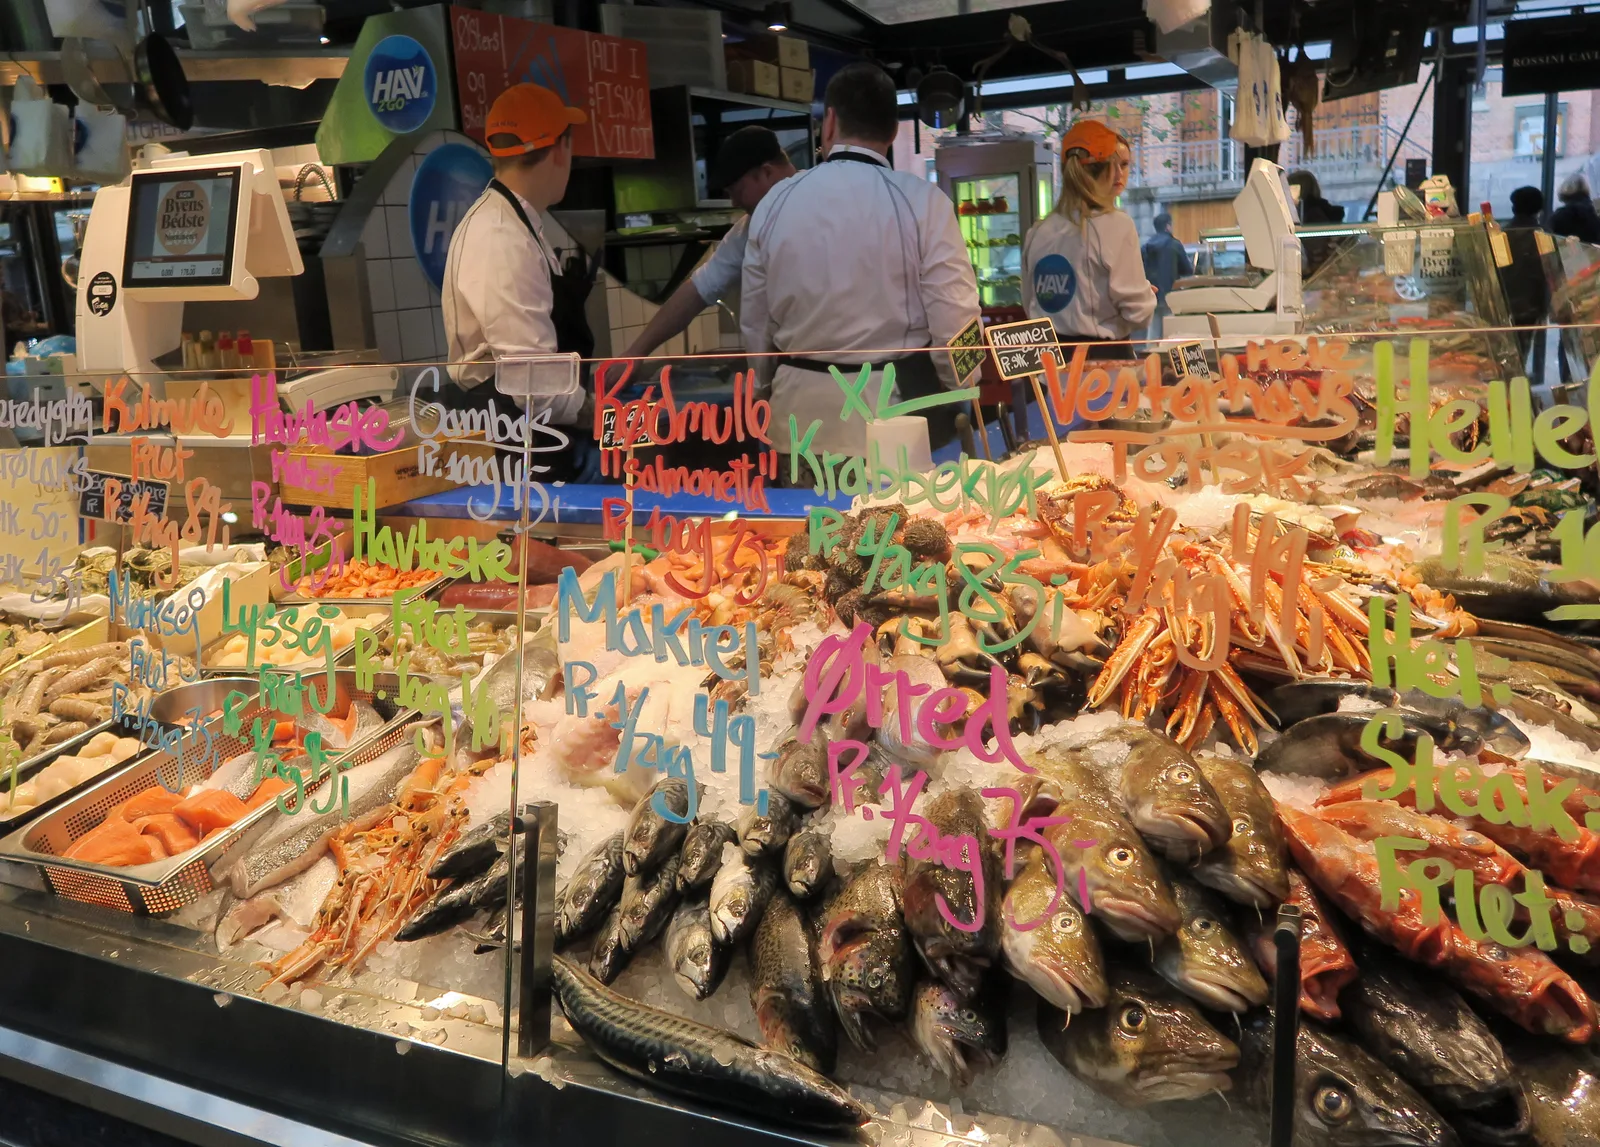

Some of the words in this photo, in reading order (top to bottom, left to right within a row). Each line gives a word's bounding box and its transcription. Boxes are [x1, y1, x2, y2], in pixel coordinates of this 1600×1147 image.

[372, 66, 425, 104] HAV
[591, 39, 620, 74] ALT
[1512, 55, 1565, 68] ROSSINI
[467, 71, 486, 105] og
[598, 122, 653, 158] VILDT
[161, 213, 205, 229] Bedste
[165, 199, 204, 213] Byens
[1036, 274, 1069, 294] HAV
[993, 324, 1053, 348] Hummer
[103, 376, 235, 438] Kulmule
[249, 371, 405, 452] Havtaske
[409, 366, 569, 452] Gambas
[593, 360, 773, 451] Rødmulle
[827, 362, 981, 423] XL
[130, 436, 194, 485] Filet
[353, 476, 521, 583] Havtaske
[222, 577, 341, 714] Lyssej
[392, 587, 478, 668] Filet
[557, 566, 760, 697] Makrel
[130, 639, 174, 692] Filet
[563, 660, 606, 719] Pr.
[796, 622, 1039, 774] Ørred
[827, 740, 875, 821] Pr.
